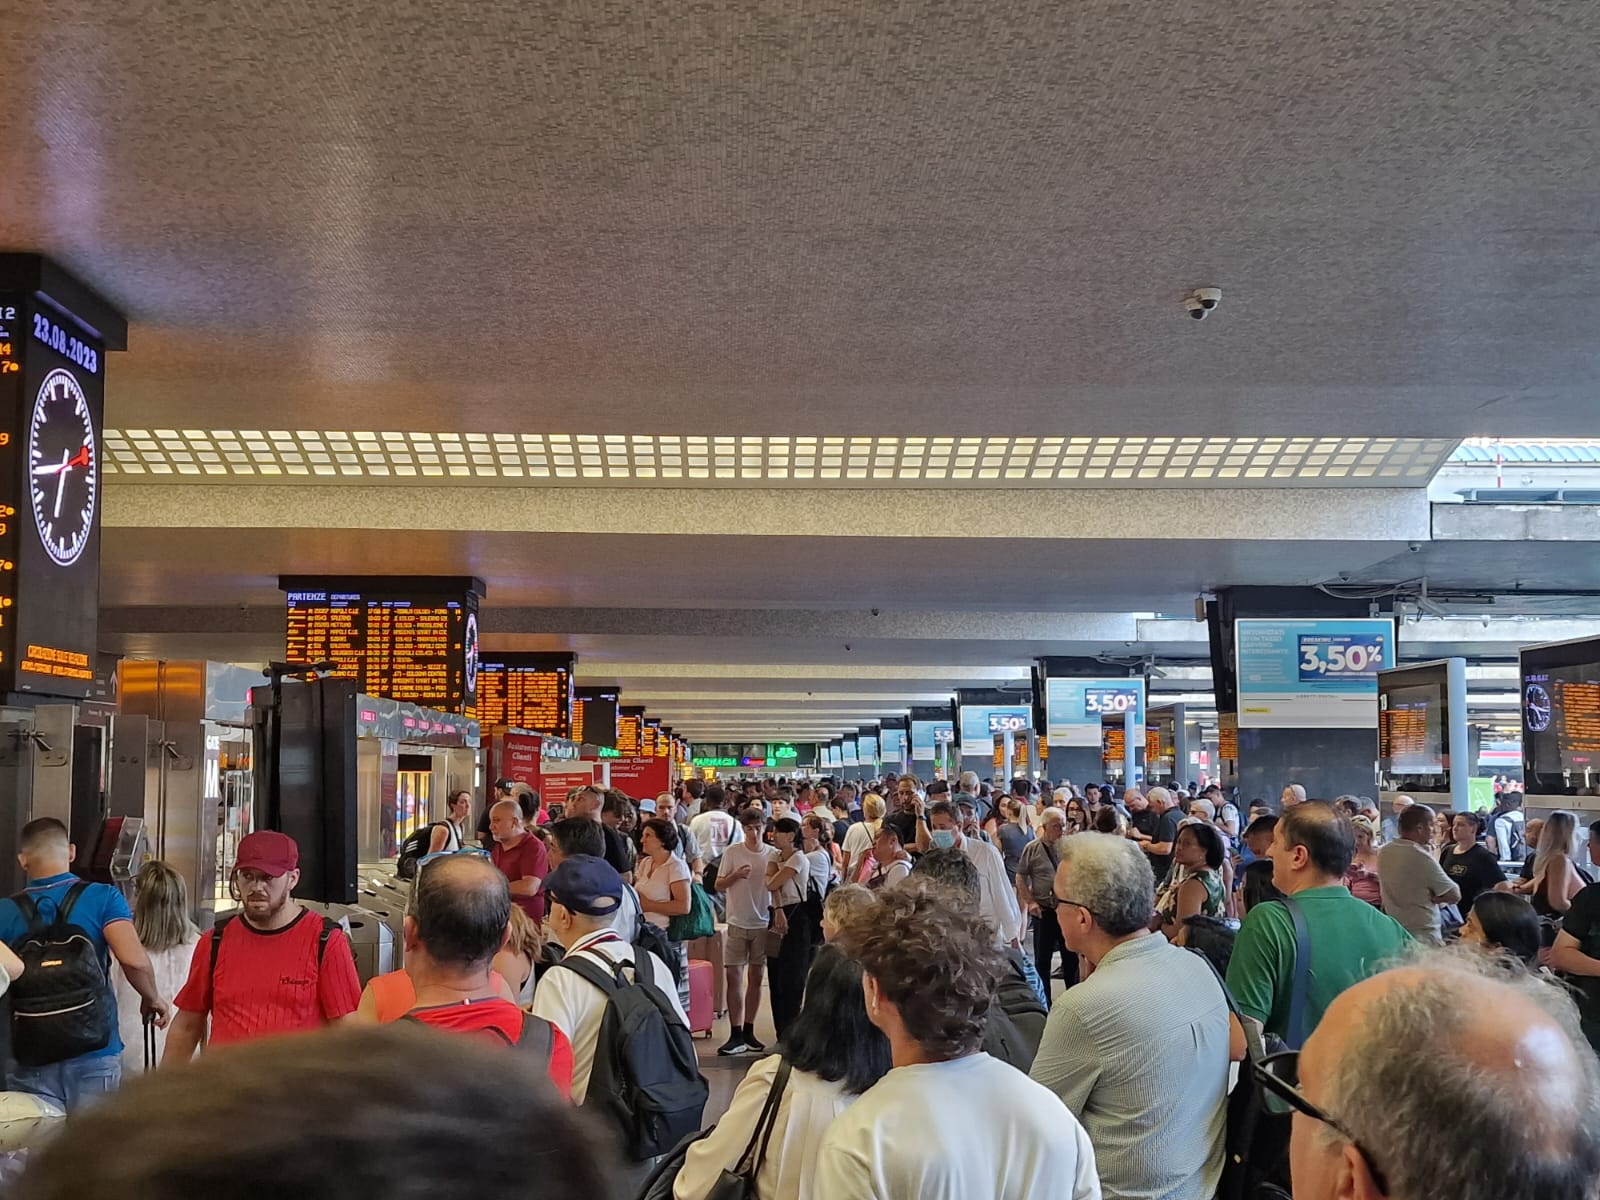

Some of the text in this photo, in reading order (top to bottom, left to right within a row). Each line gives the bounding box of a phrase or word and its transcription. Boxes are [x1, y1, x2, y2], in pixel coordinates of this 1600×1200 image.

[34, 313, 97, 374] 23.08.2023
[287, 592, 326, 600] PARTENZE
[1300, 645, 1382, 674] 3,50%
[1086, 694, 1137, 712] 3,50%
[989, 717, 1027, 731] 3,50%
[512, 752, 532, 761] Clienti
